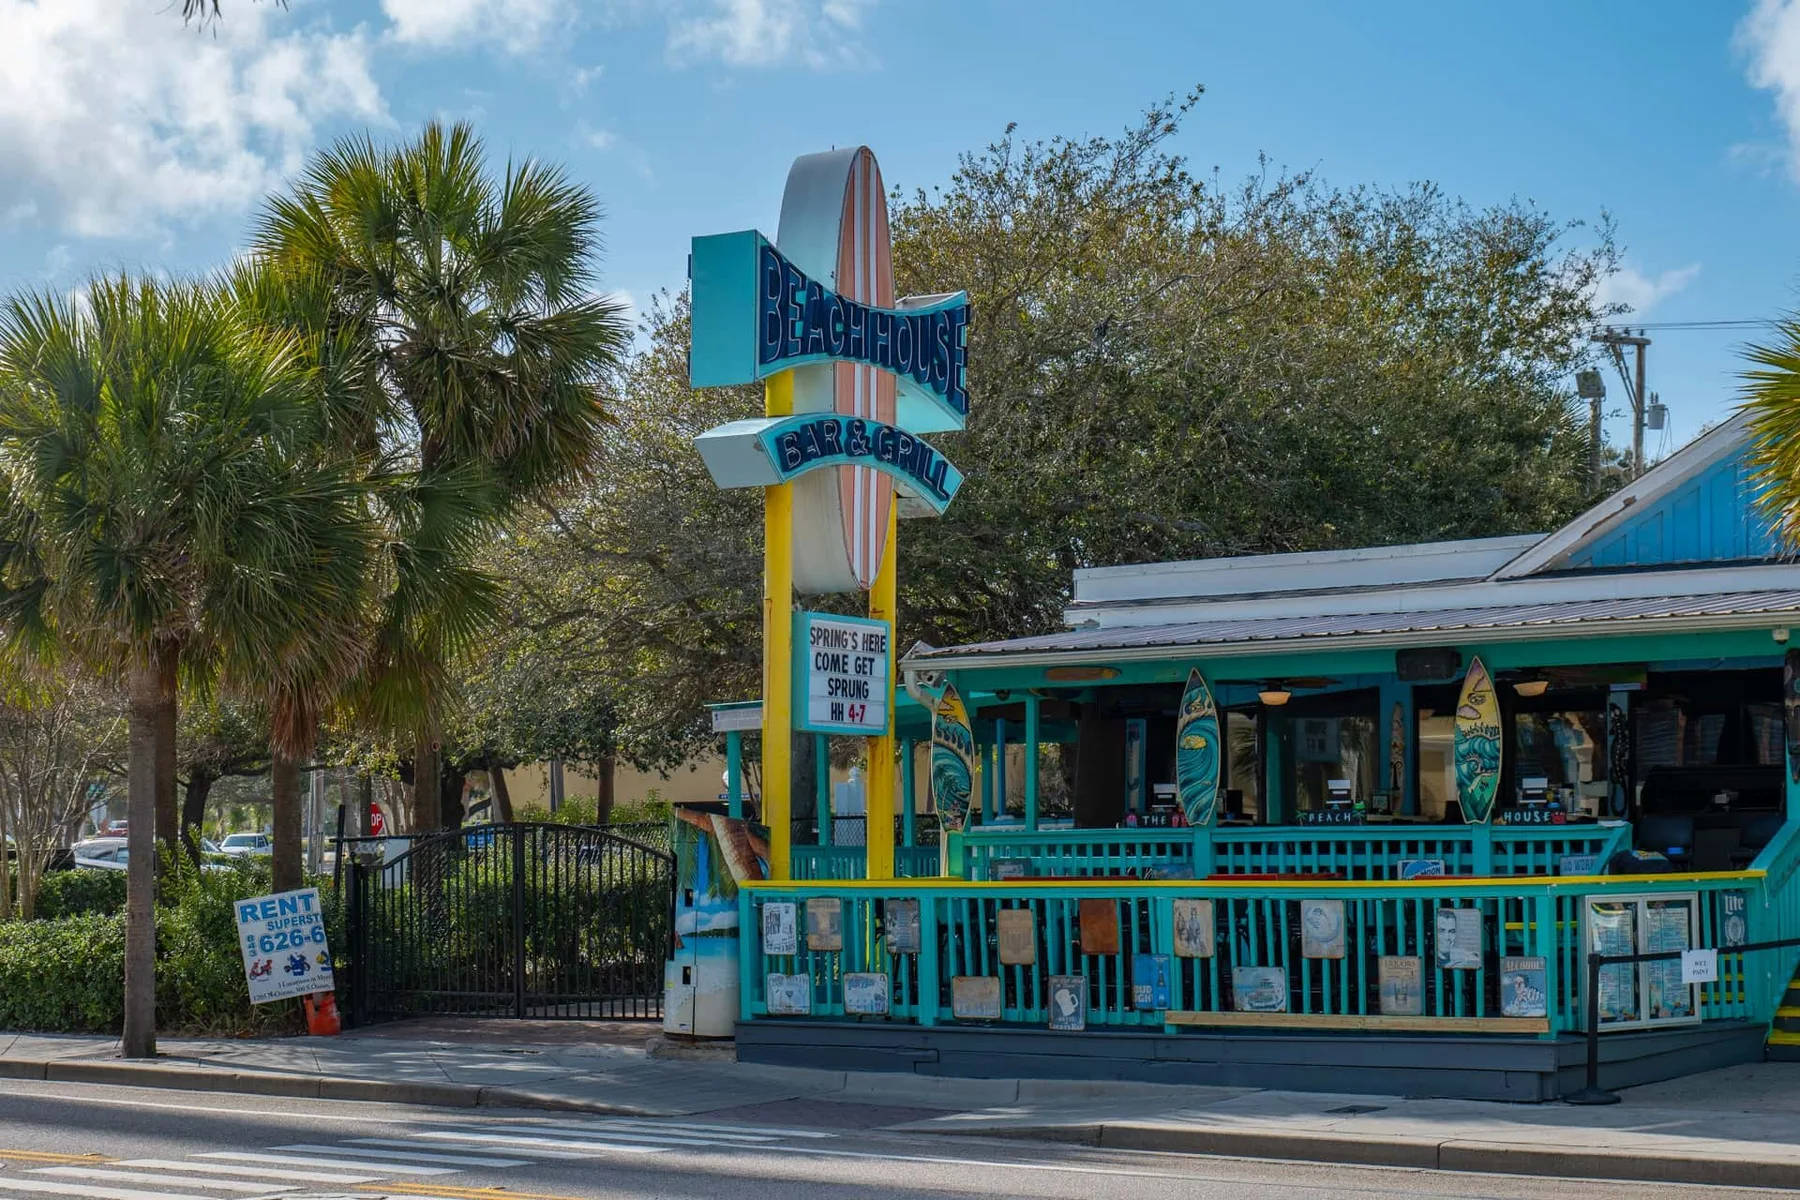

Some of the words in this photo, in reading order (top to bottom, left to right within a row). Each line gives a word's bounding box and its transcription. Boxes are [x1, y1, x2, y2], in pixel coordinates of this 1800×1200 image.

[759, 245, 869, 366] BEACH
[870, 303, 970, 414] HOUSE
[775, 418, 843, 473] BAR
[846, 419, 872, 458] &
[873, 426, 951, 501] GRILL
[809, 626, 858, 650] SPRING'S
[862, 633, 886, 653] HERE
[815, 652, 849, 674] COME
[854, 656, 875, 676] GET
[827, 677, 869, 699] SPRUNG
[831, 701, 844, 721] HH
[848, 703, 866, 722] 4-7
[1142, 815, 1167, 826] THE
[1308, 812, 1351, 822] BEACH
[1503, 810, 1550, 822] HOUSE
[240, 893, 315, 924] RENT
[1725, 895, 1744, 915] Lite
[267, 912, 320, 931] SUPERST
[259, 925, 325, 953] 626-6
